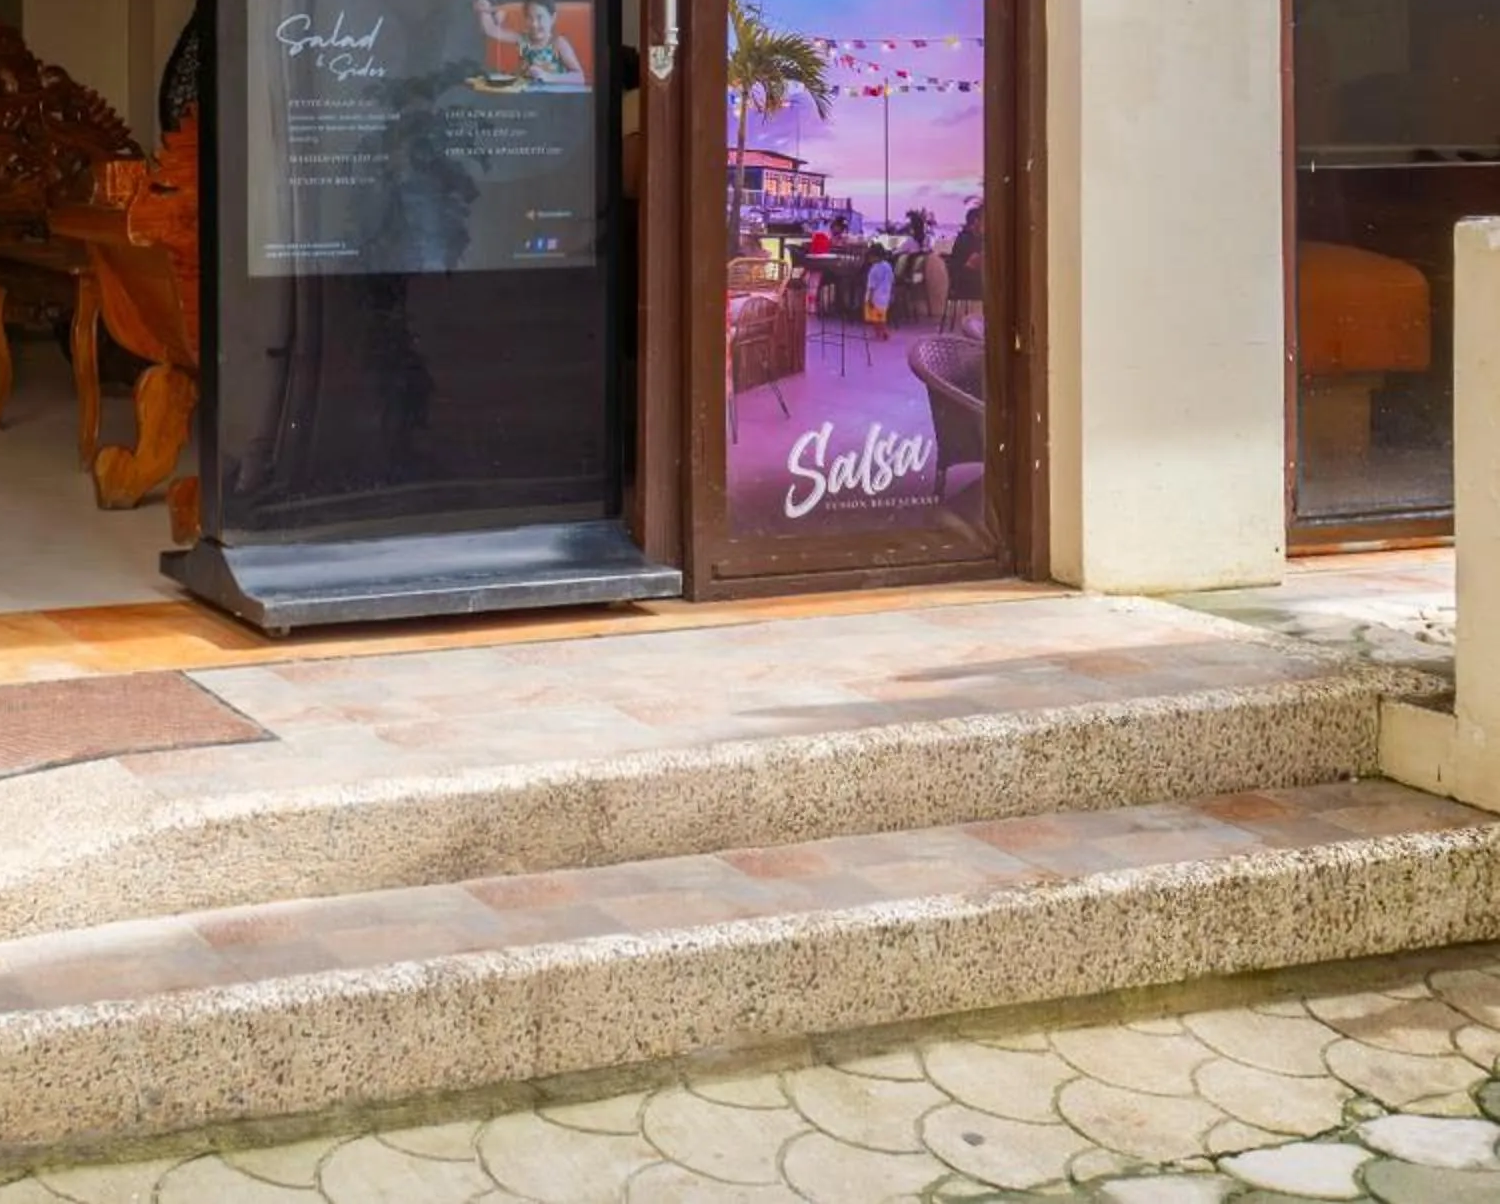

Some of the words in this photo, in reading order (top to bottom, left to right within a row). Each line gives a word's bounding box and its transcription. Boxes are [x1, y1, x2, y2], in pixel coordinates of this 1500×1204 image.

[276, 11, 385, 57] Salad
[329, 52, 388, 83] Sides
[784, 420, 933, 519] Salsa
